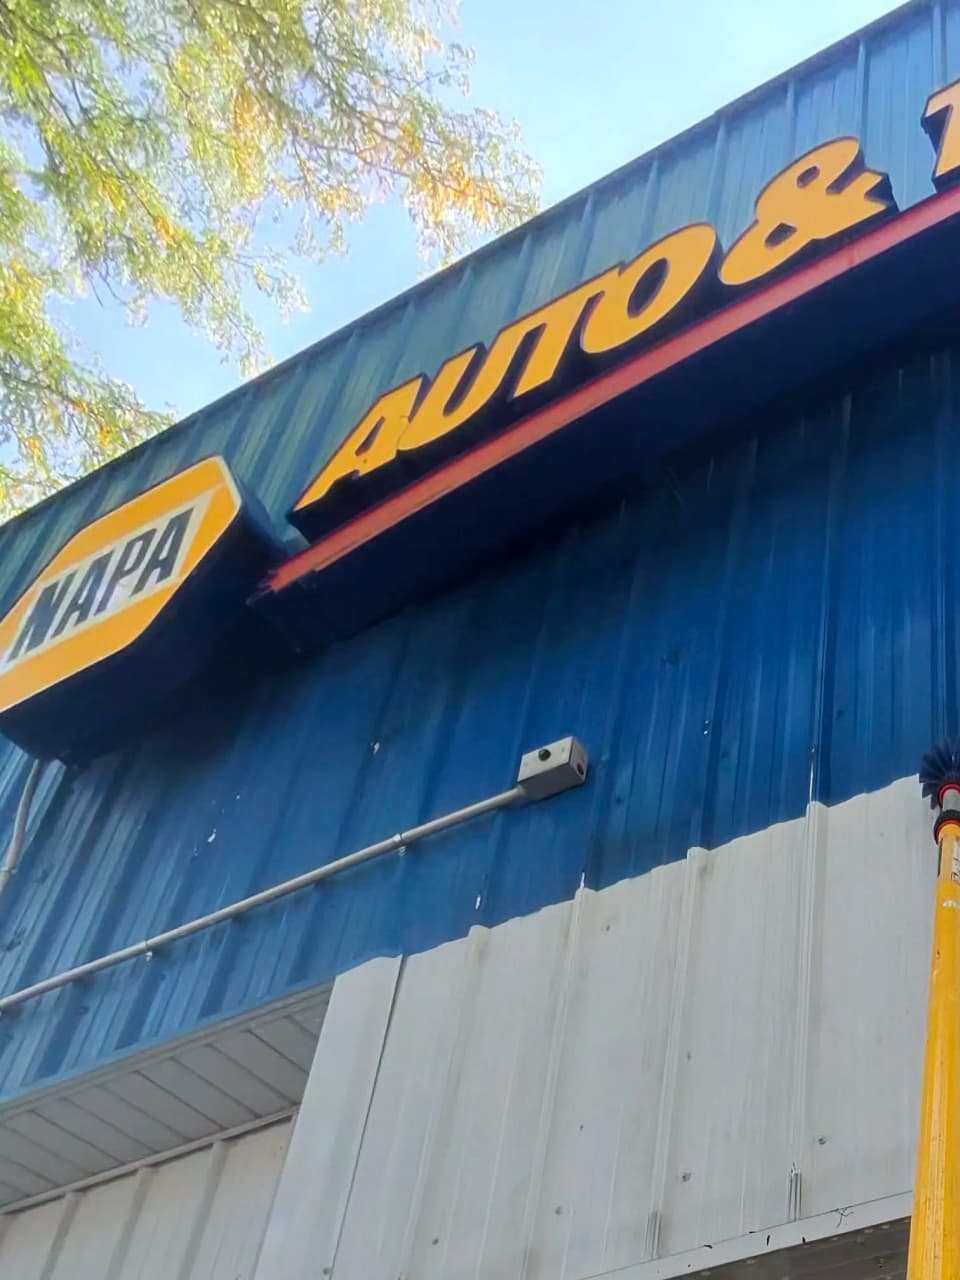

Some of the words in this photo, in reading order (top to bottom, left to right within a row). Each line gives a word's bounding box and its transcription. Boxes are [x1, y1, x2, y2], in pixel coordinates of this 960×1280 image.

[292, 222, 718, 513] AUTO
[719, 136, 889, 286] &
[6, 506, 195, 665] NAPA
